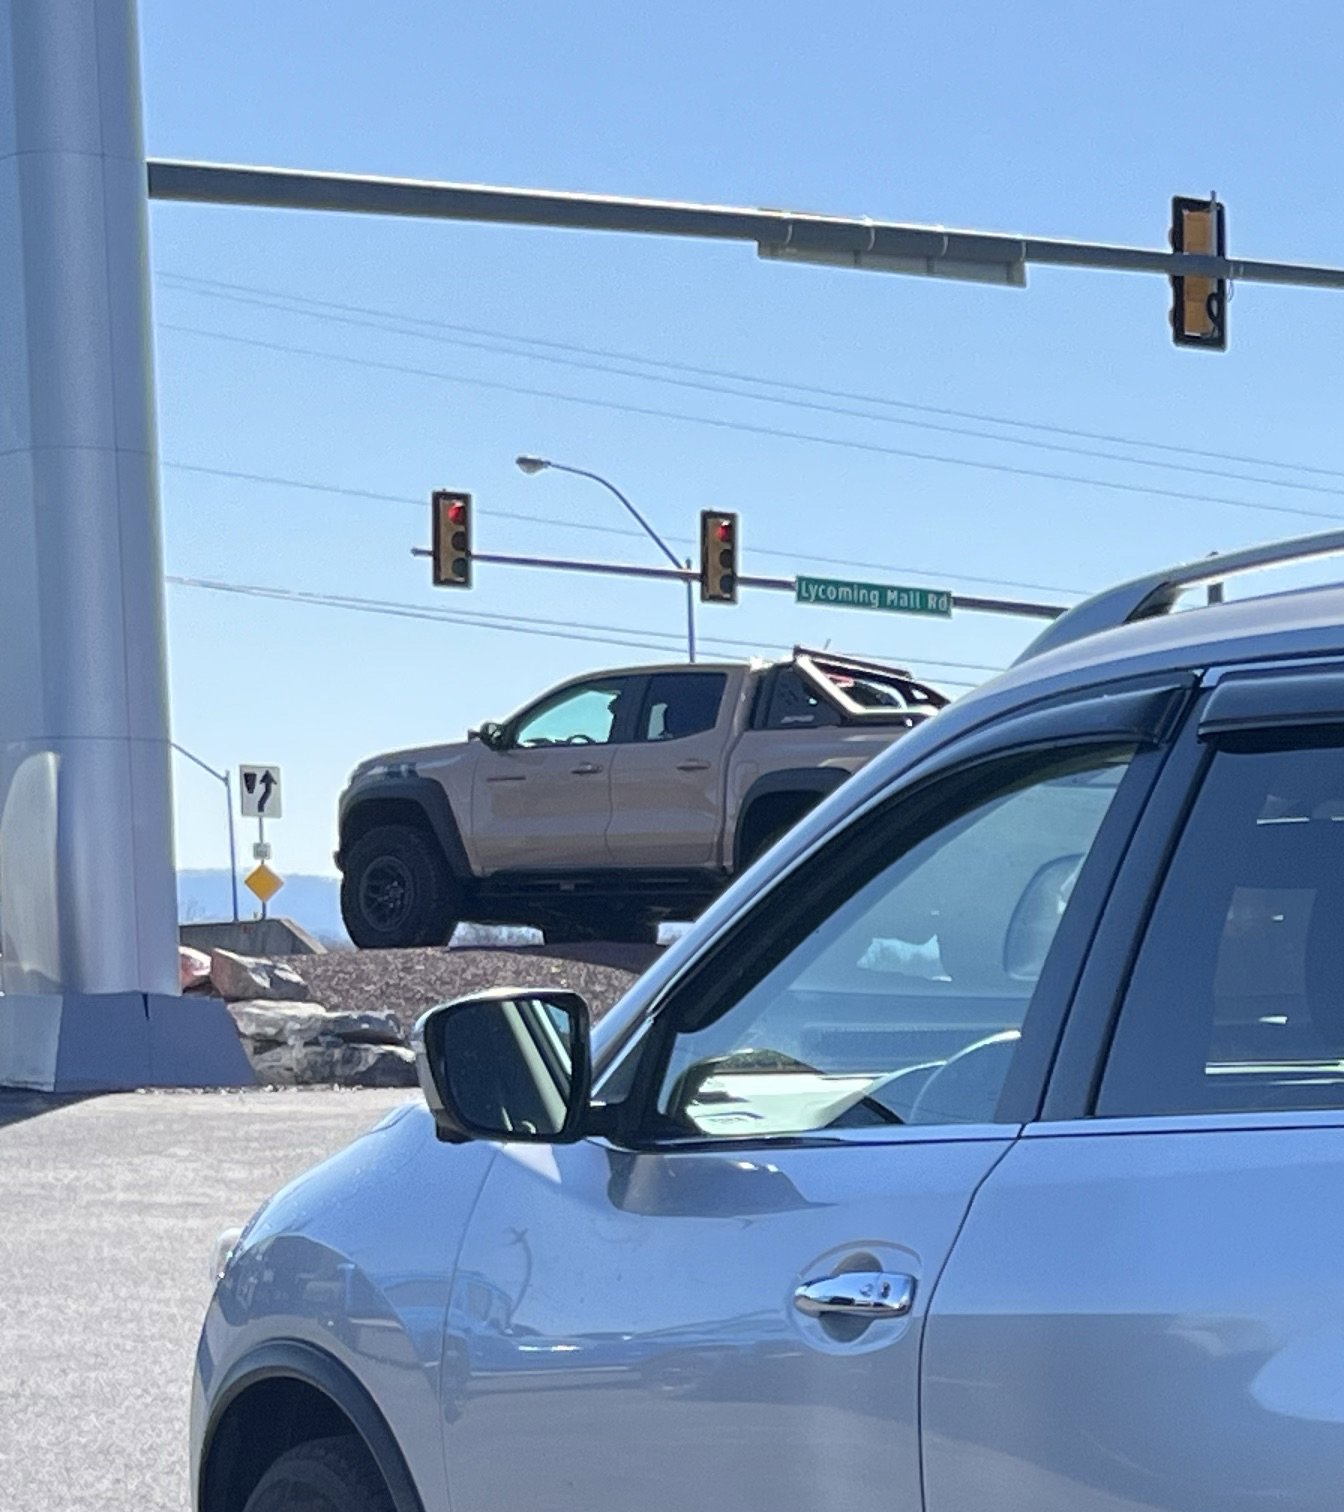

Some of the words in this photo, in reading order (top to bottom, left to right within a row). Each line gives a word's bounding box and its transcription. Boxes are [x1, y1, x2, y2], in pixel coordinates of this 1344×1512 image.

[801, 580, 879, 608] Lycoming
[886, 590, 920, 609] Mall
[927, 593, 948, 611] Rd
